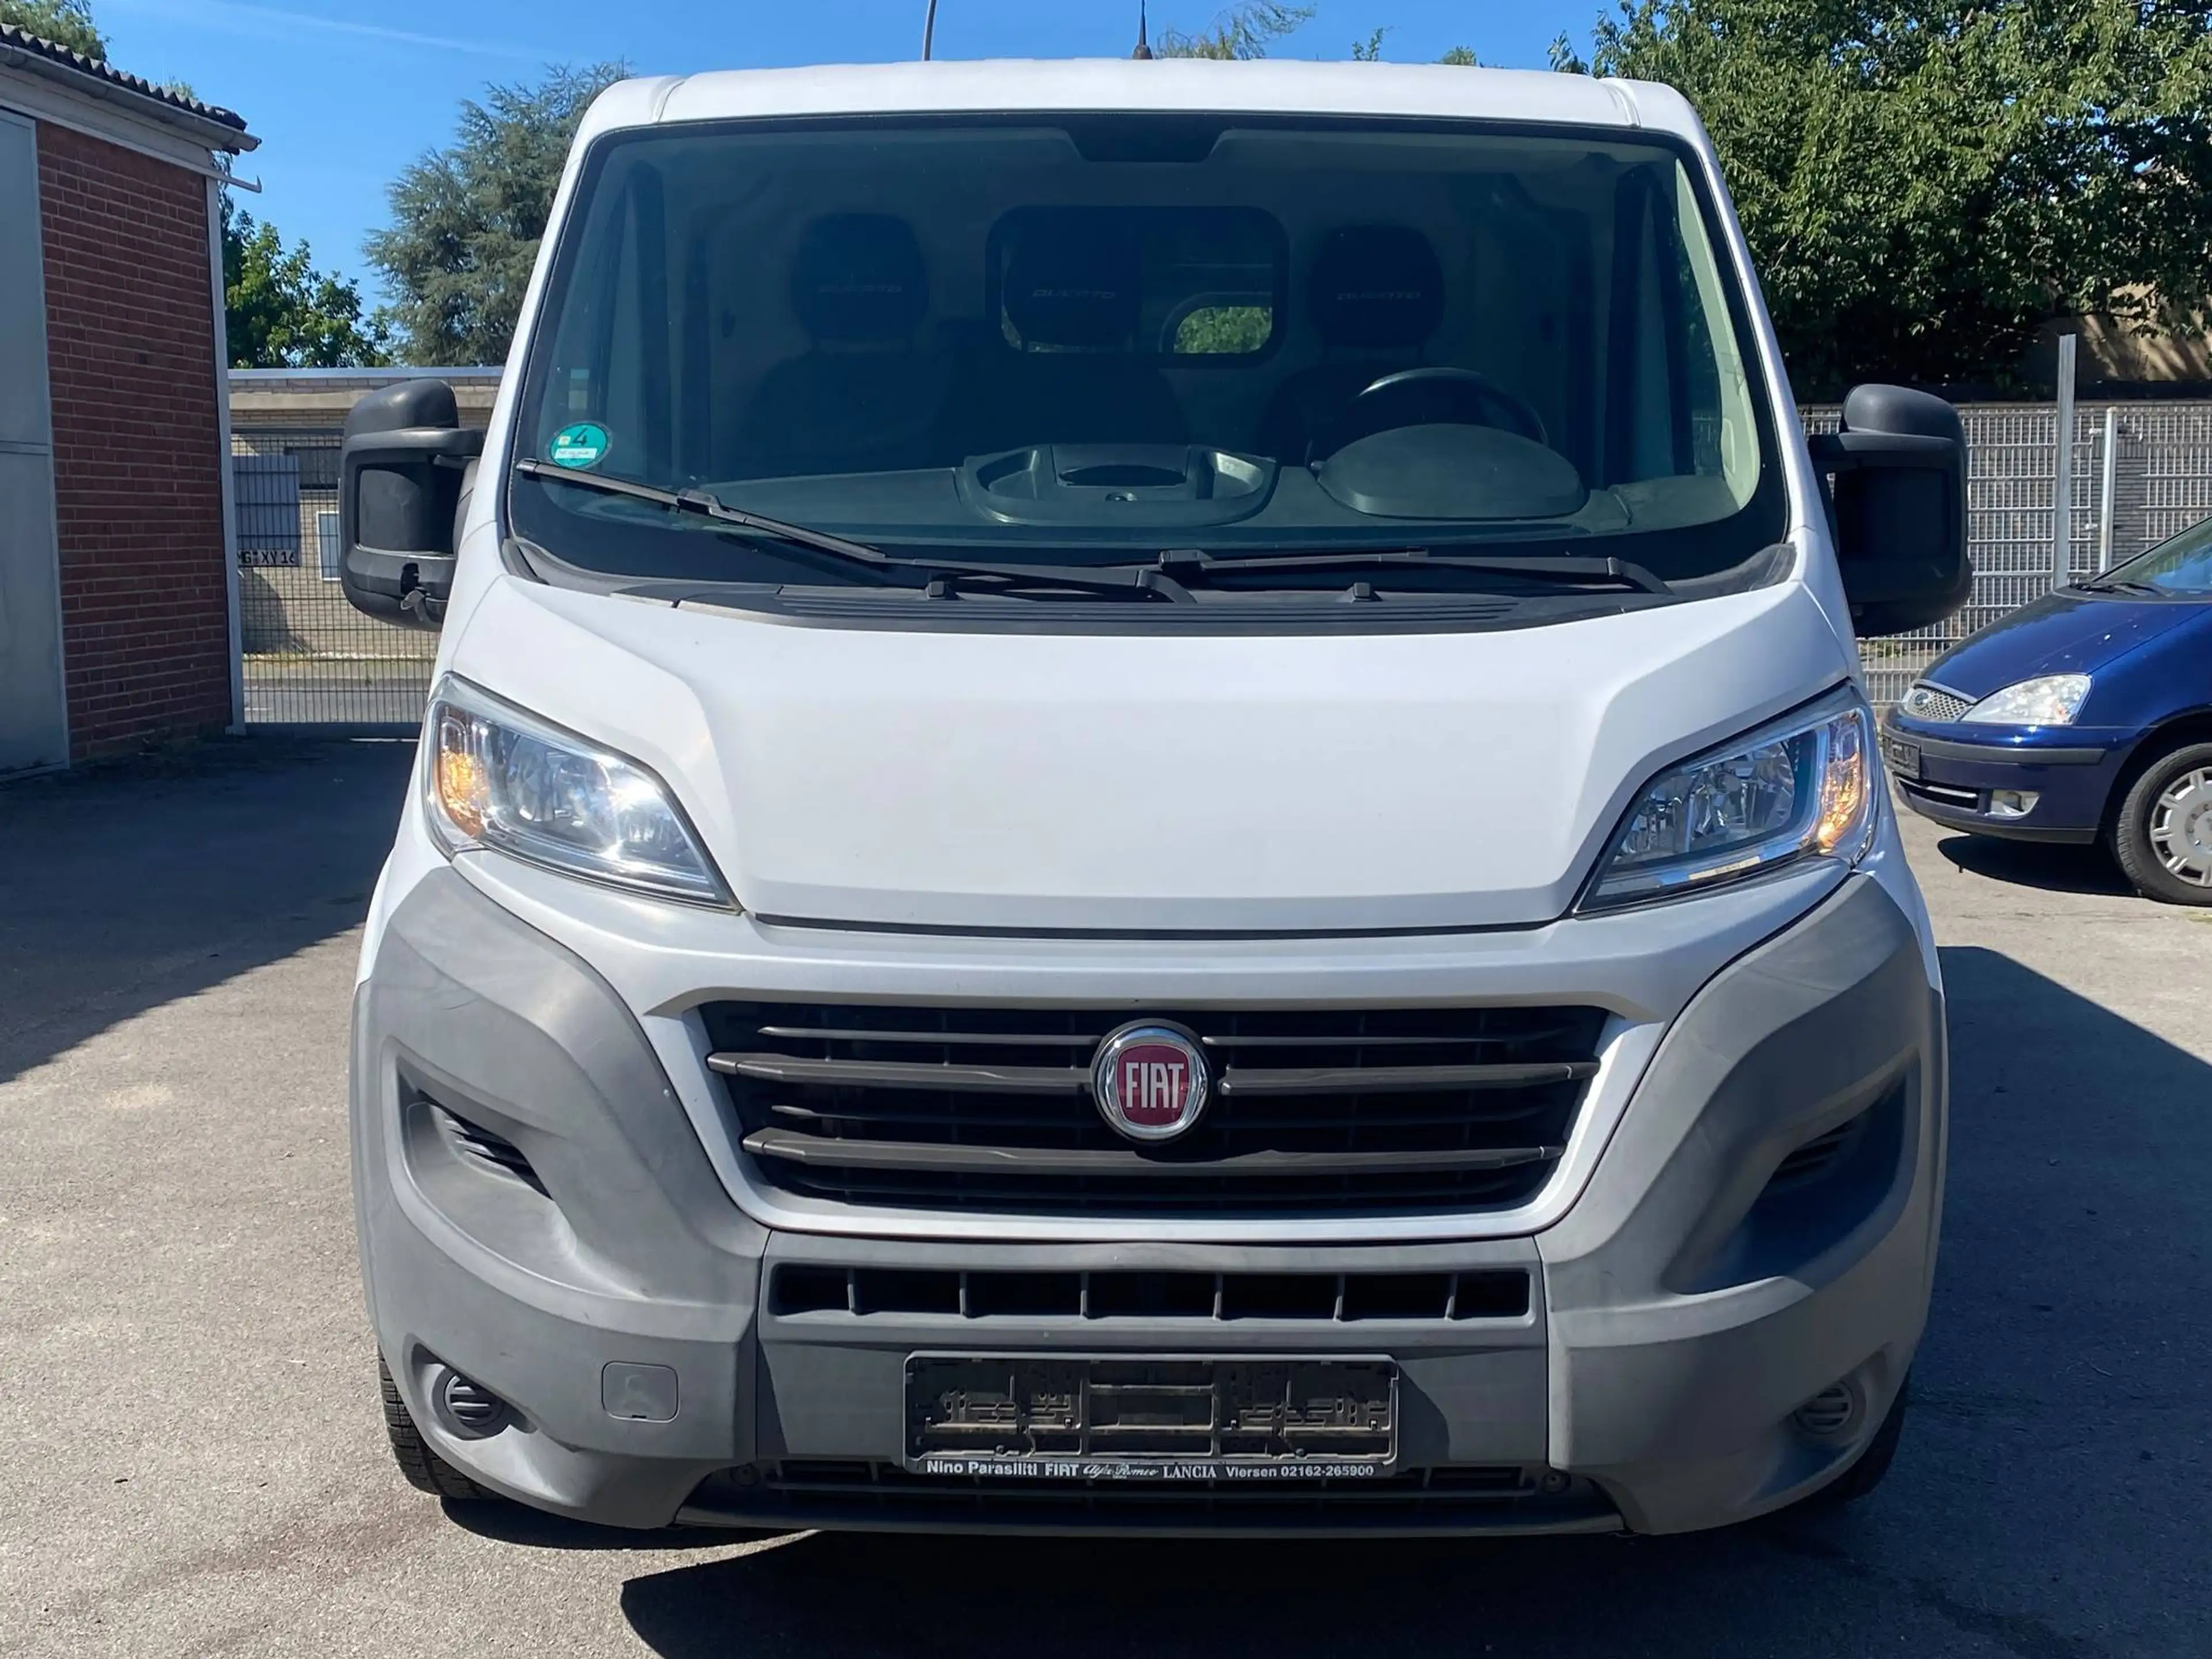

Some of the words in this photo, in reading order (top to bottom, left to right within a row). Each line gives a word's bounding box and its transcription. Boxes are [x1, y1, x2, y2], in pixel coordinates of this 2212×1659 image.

[571, 427, 588, 446] 4
[1125, 1062, 1185, 1108] FIAT
[926, 1460, 963, 1474] Nino
[968, 1461, 1037, 1475] Parasiliti
[1044, 1463, 1079, 1476] FIAT
[1164, 1465, 1217, 1478] LANCIA
[1226, 1466, 1277, 1478] Viersen
[1281, 1465, 1374, 1476] 02162-265900
